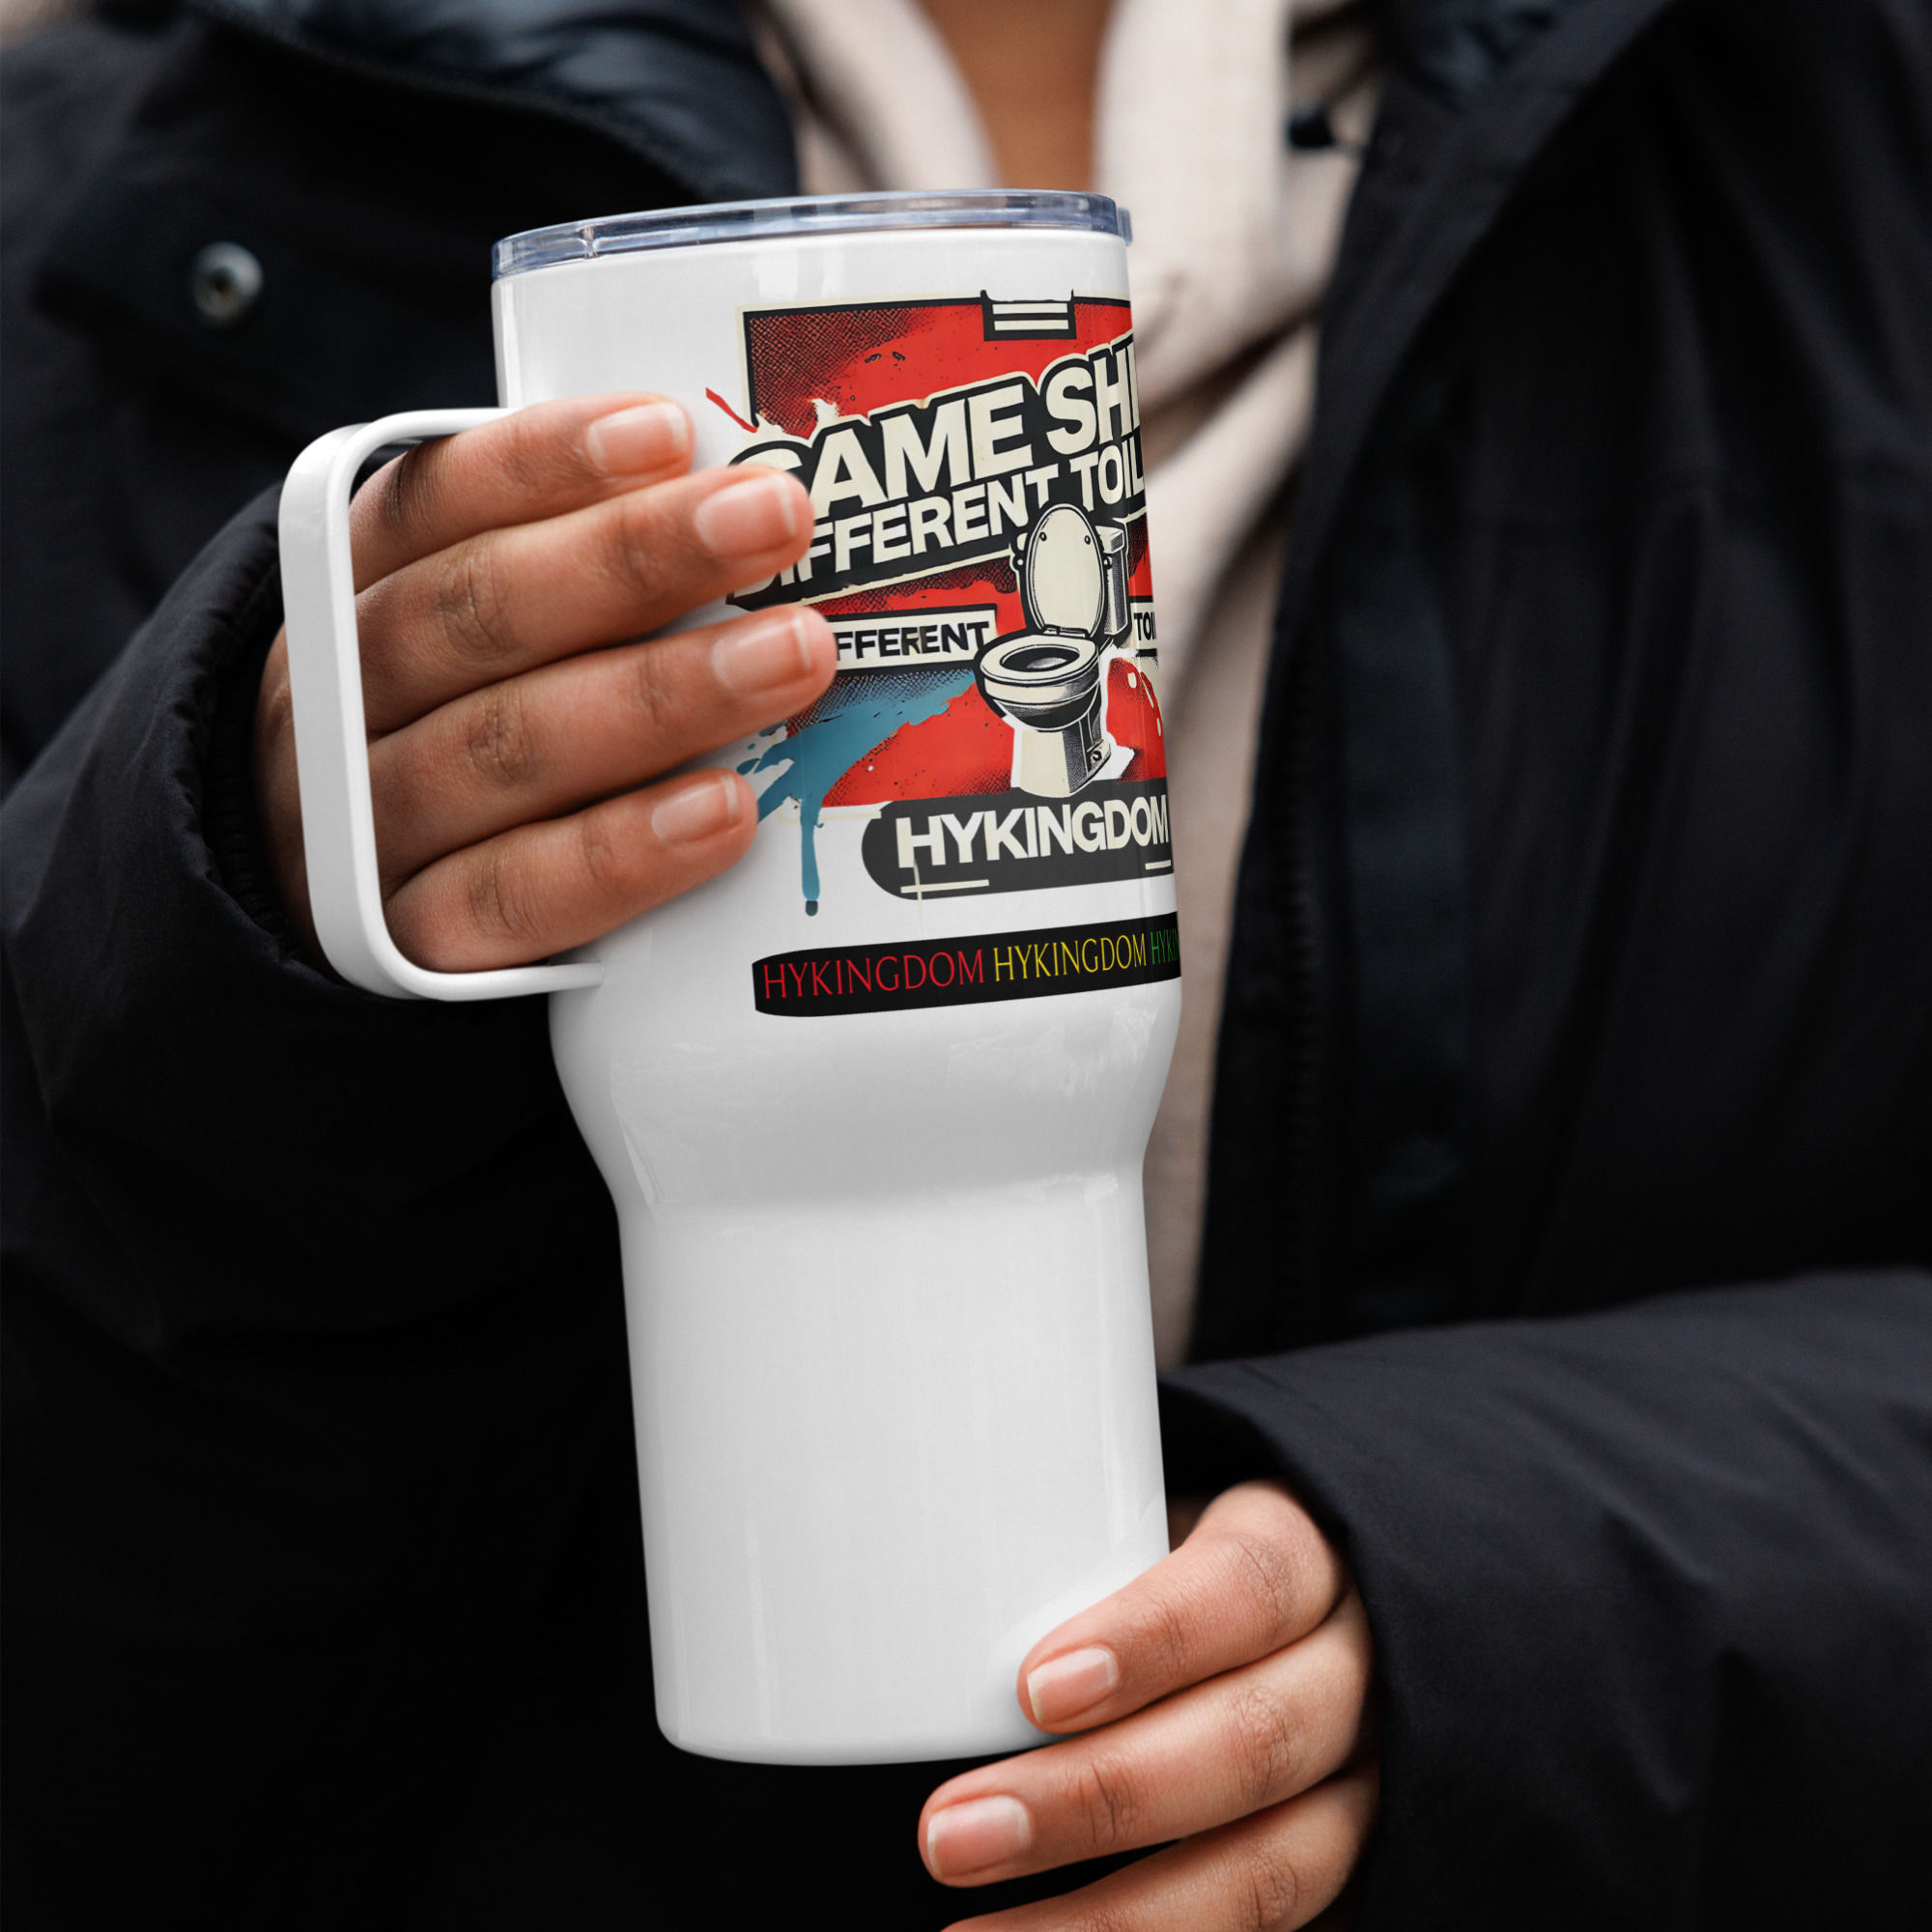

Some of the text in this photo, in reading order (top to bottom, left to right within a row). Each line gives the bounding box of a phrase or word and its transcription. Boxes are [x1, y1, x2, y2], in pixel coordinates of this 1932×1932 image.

[734, 464, 1059, 598] FFERENT
[1133, 611, 1156, 640] TOI
[895, 794, 1170, 868] HYKINGDOM
[762, 949, 985, 999] HYKINGDOM
[992, 933, 1147, 982] HYKINGDOM
